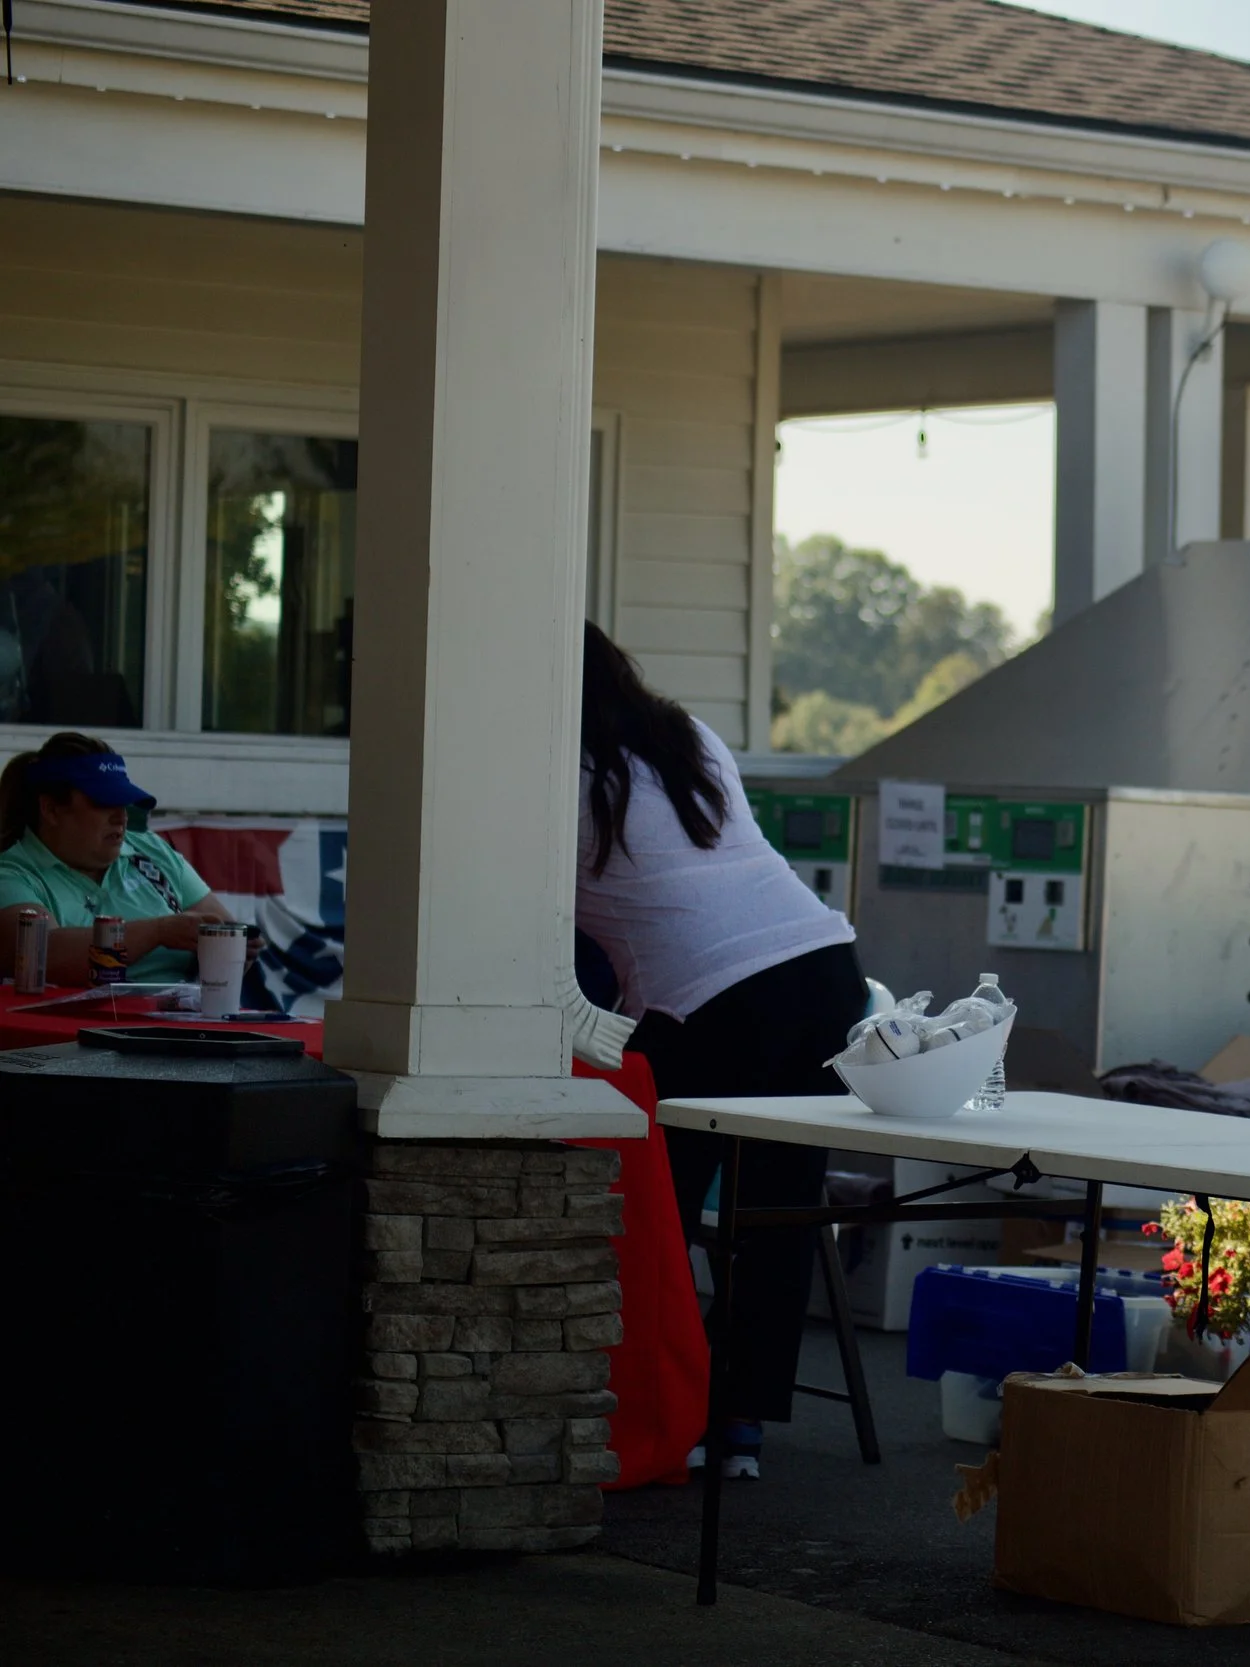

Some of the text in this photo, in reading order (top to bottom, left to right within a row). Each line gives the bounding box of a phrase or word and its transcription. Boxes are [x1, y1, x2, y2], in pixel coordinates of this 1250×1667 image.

[917, 1237, 1001, 1251] next level app
